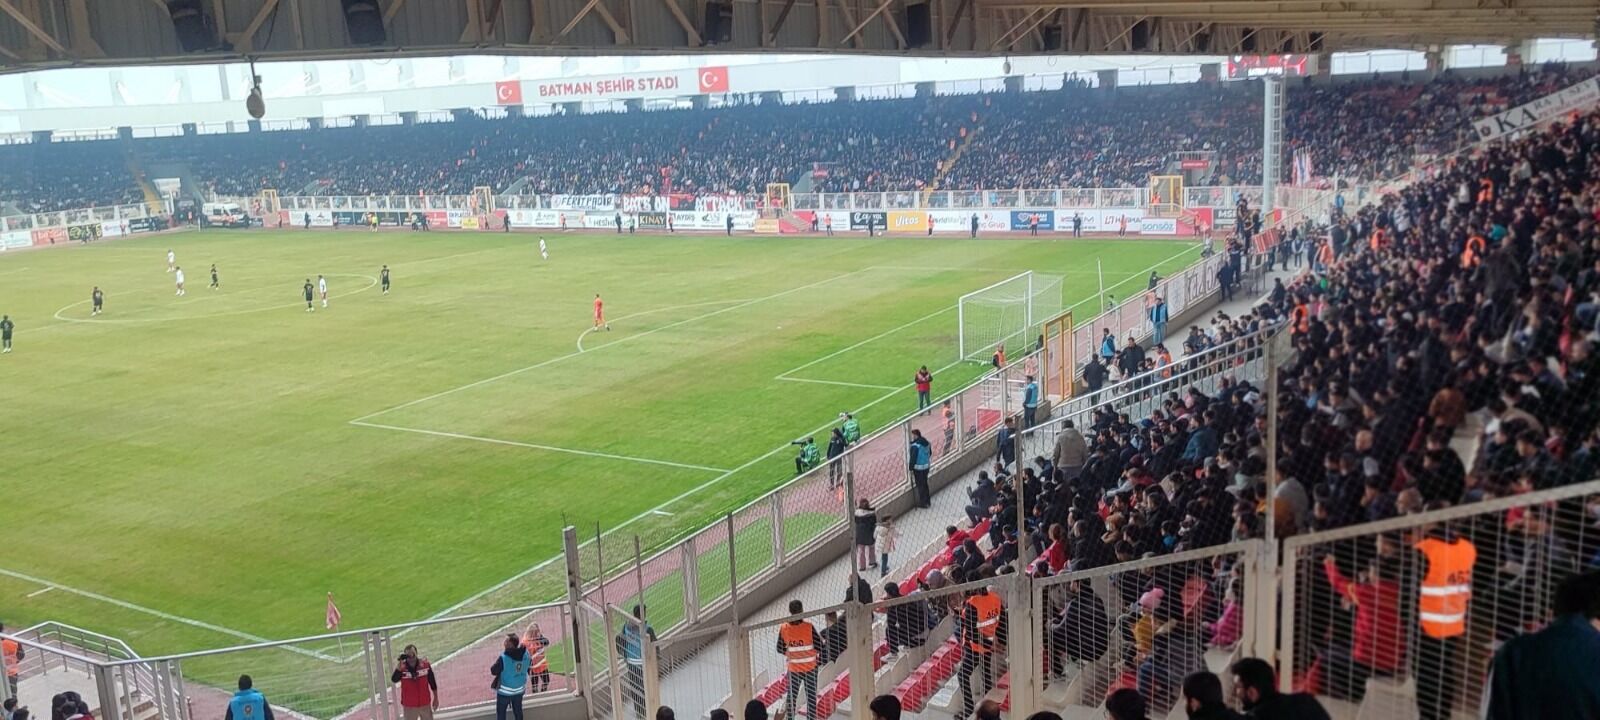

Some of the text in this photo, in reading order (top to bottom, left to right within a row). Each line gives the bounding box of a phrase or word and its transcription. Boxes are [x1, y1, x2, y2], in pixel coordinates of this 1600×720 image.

[539, 76, 679, 97] BATMAN ŞEHİR STADI
[640, 215, 665, 225] KINAY
